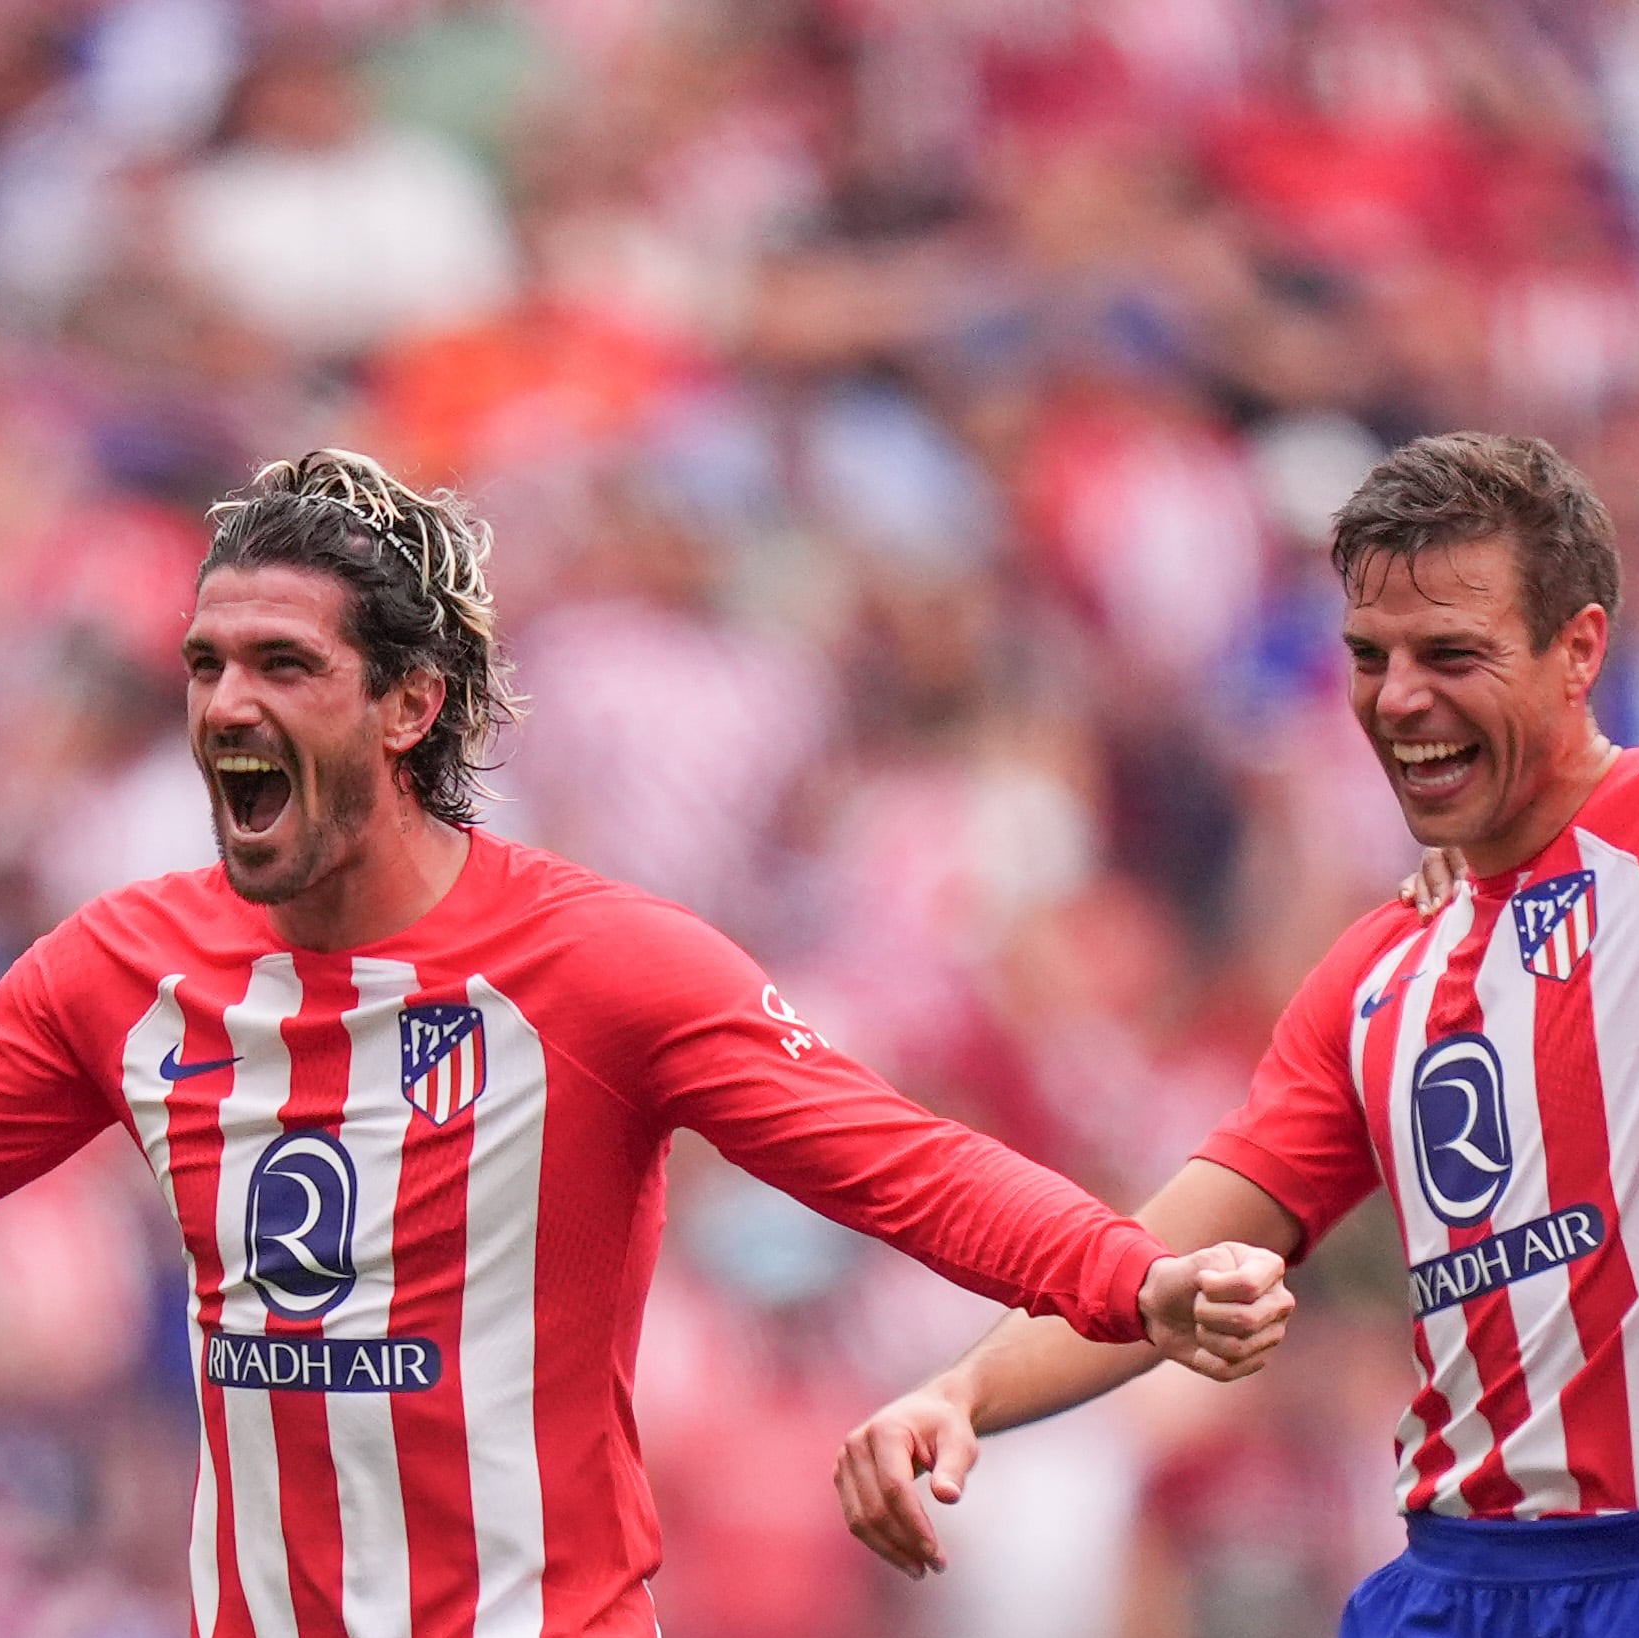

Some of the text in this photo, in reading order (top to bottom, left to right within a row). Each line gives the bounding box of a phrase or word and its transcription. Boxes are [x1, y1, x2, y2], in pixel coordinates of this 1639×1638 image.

[1410, 1211, 1599, 1313] IYADH AIR
[208, 1337, 430, 1386] RIYADH AIR
